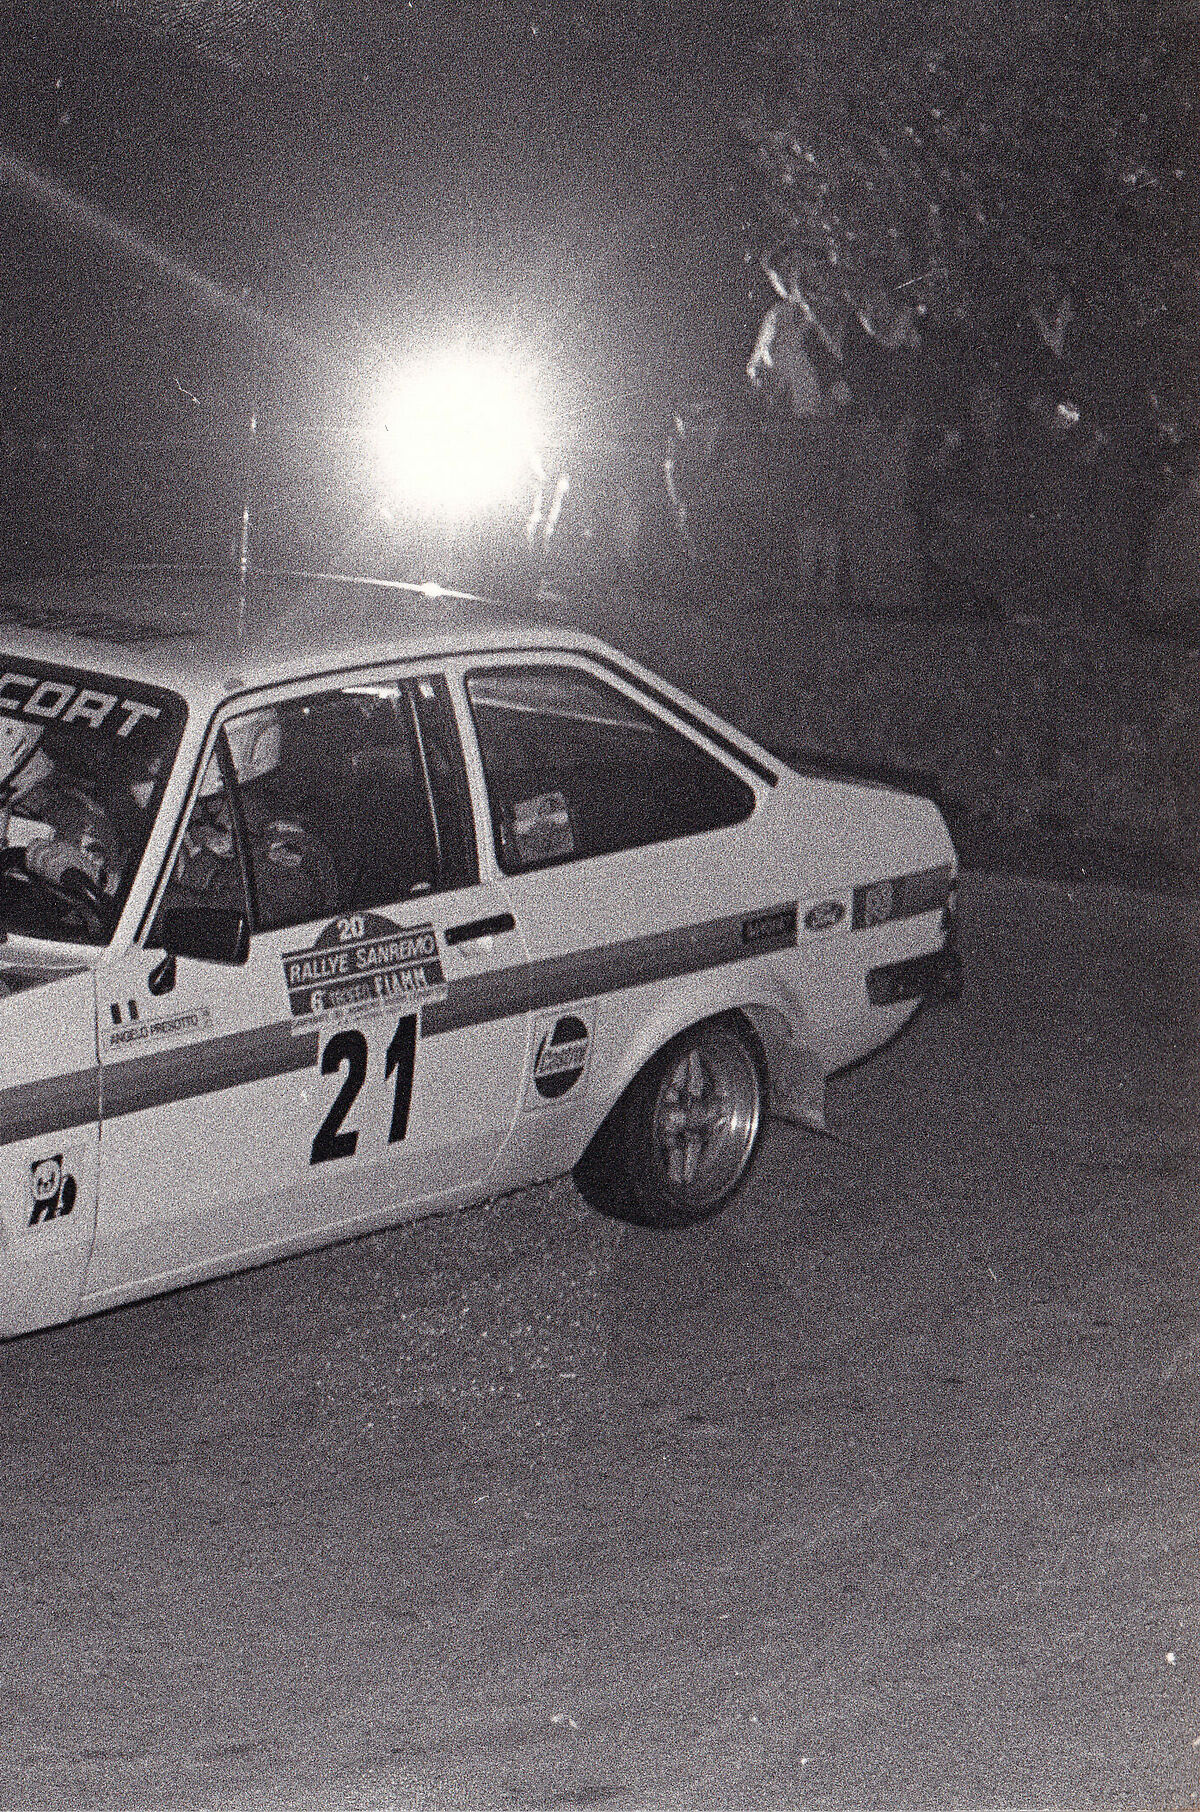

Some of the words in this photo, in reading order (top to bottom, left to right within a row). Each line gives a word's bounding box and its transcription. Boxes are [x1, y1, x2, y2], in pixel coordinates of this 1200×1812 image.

[337, 915, 365, 941] 20
[289, 954, 351, 984] RALLYE
[356, 934, 437, 969] SANREMO
[374, 966, 429, 999] FIAMM
[309, 1012, 418, 1166] 21
